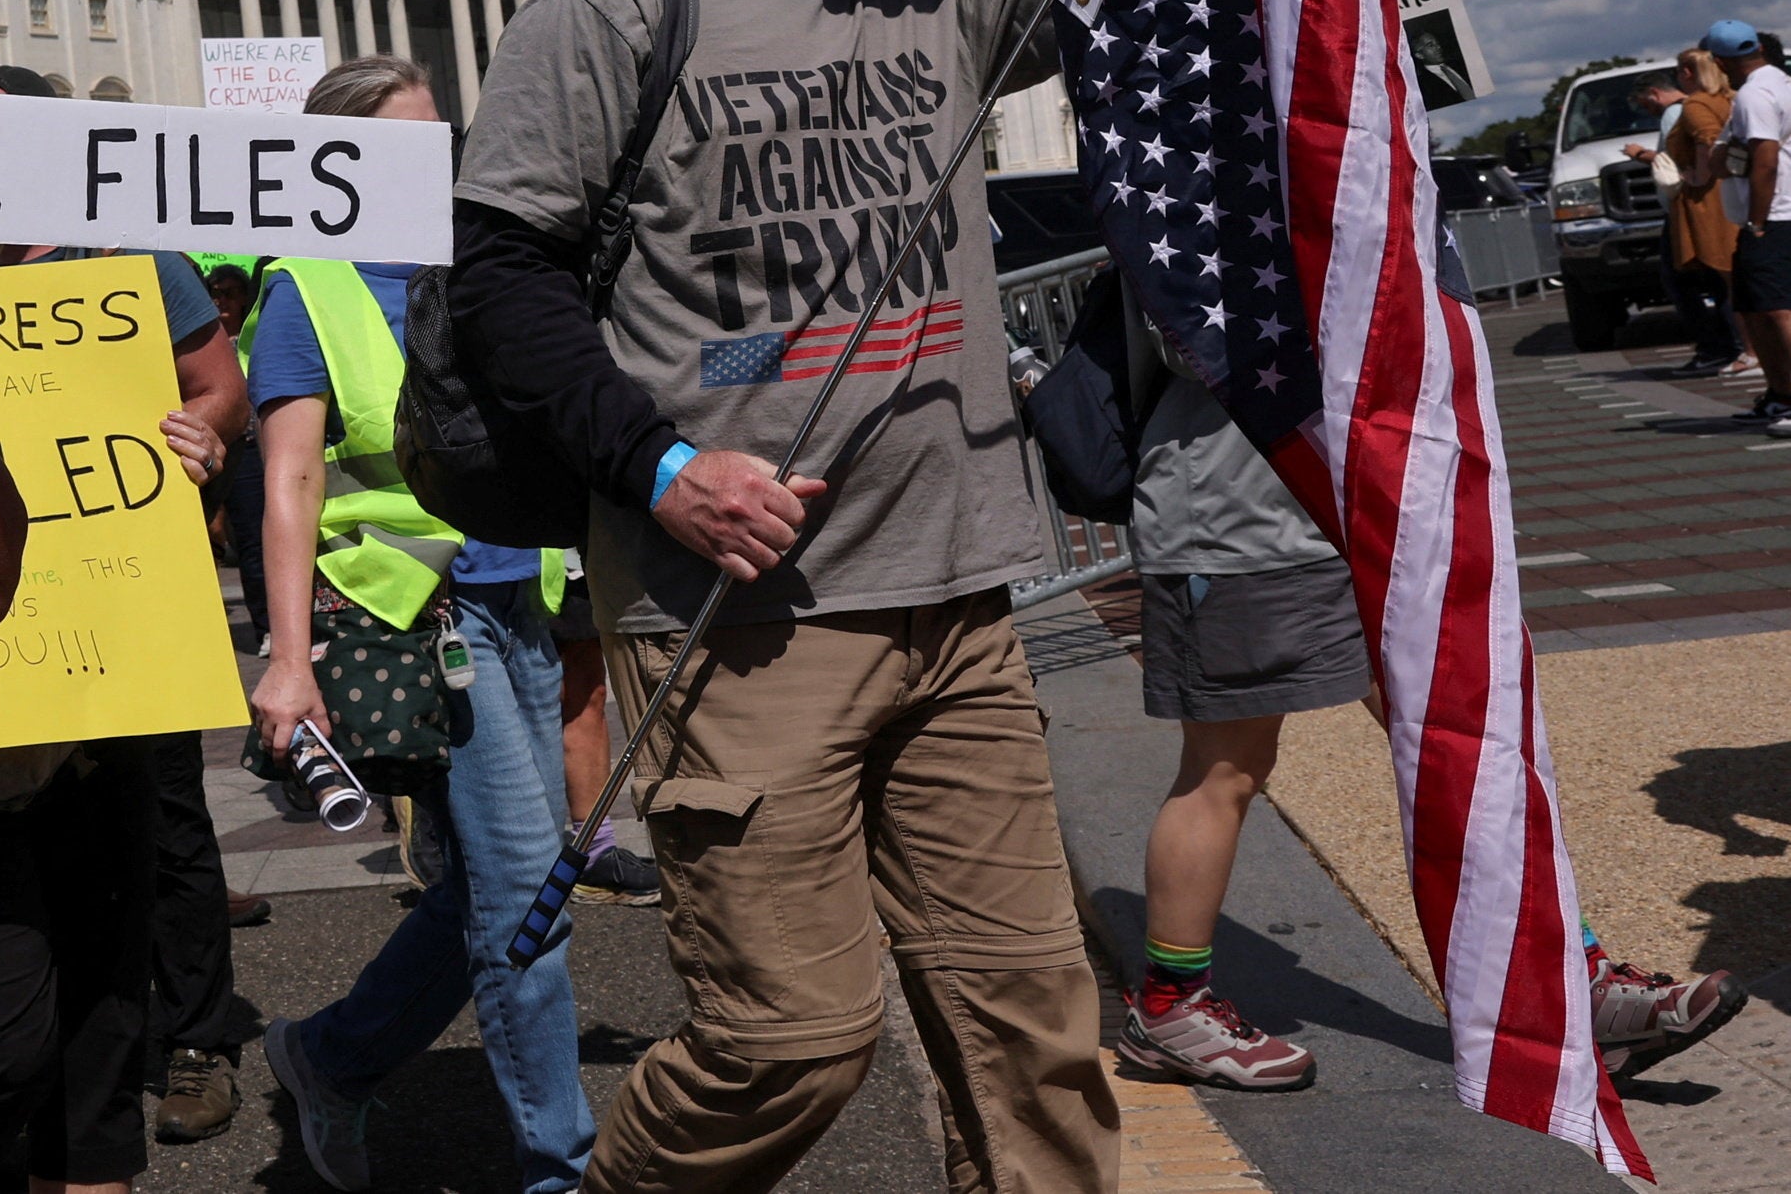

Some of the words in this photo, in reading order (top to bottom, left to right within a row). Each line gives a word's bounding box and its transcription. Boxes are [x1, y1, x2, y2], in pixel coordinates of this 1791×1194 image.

[203, 42, 269, 63] WHERE
[274, 43, 316, 63] ARE
[213, 66, 255, 84] THE
[268, 67, 301, 83] D.C.
[209, 87, 315, 106] CRIMINAL
[675, 48, 947, 143] VETERANS
[86, 128, 361, 236] FILES
[719, 122, 940, 221] AGAINST
[690, 190, 959, 331] TRUMP
[81, 556, 142, 579] THIS
